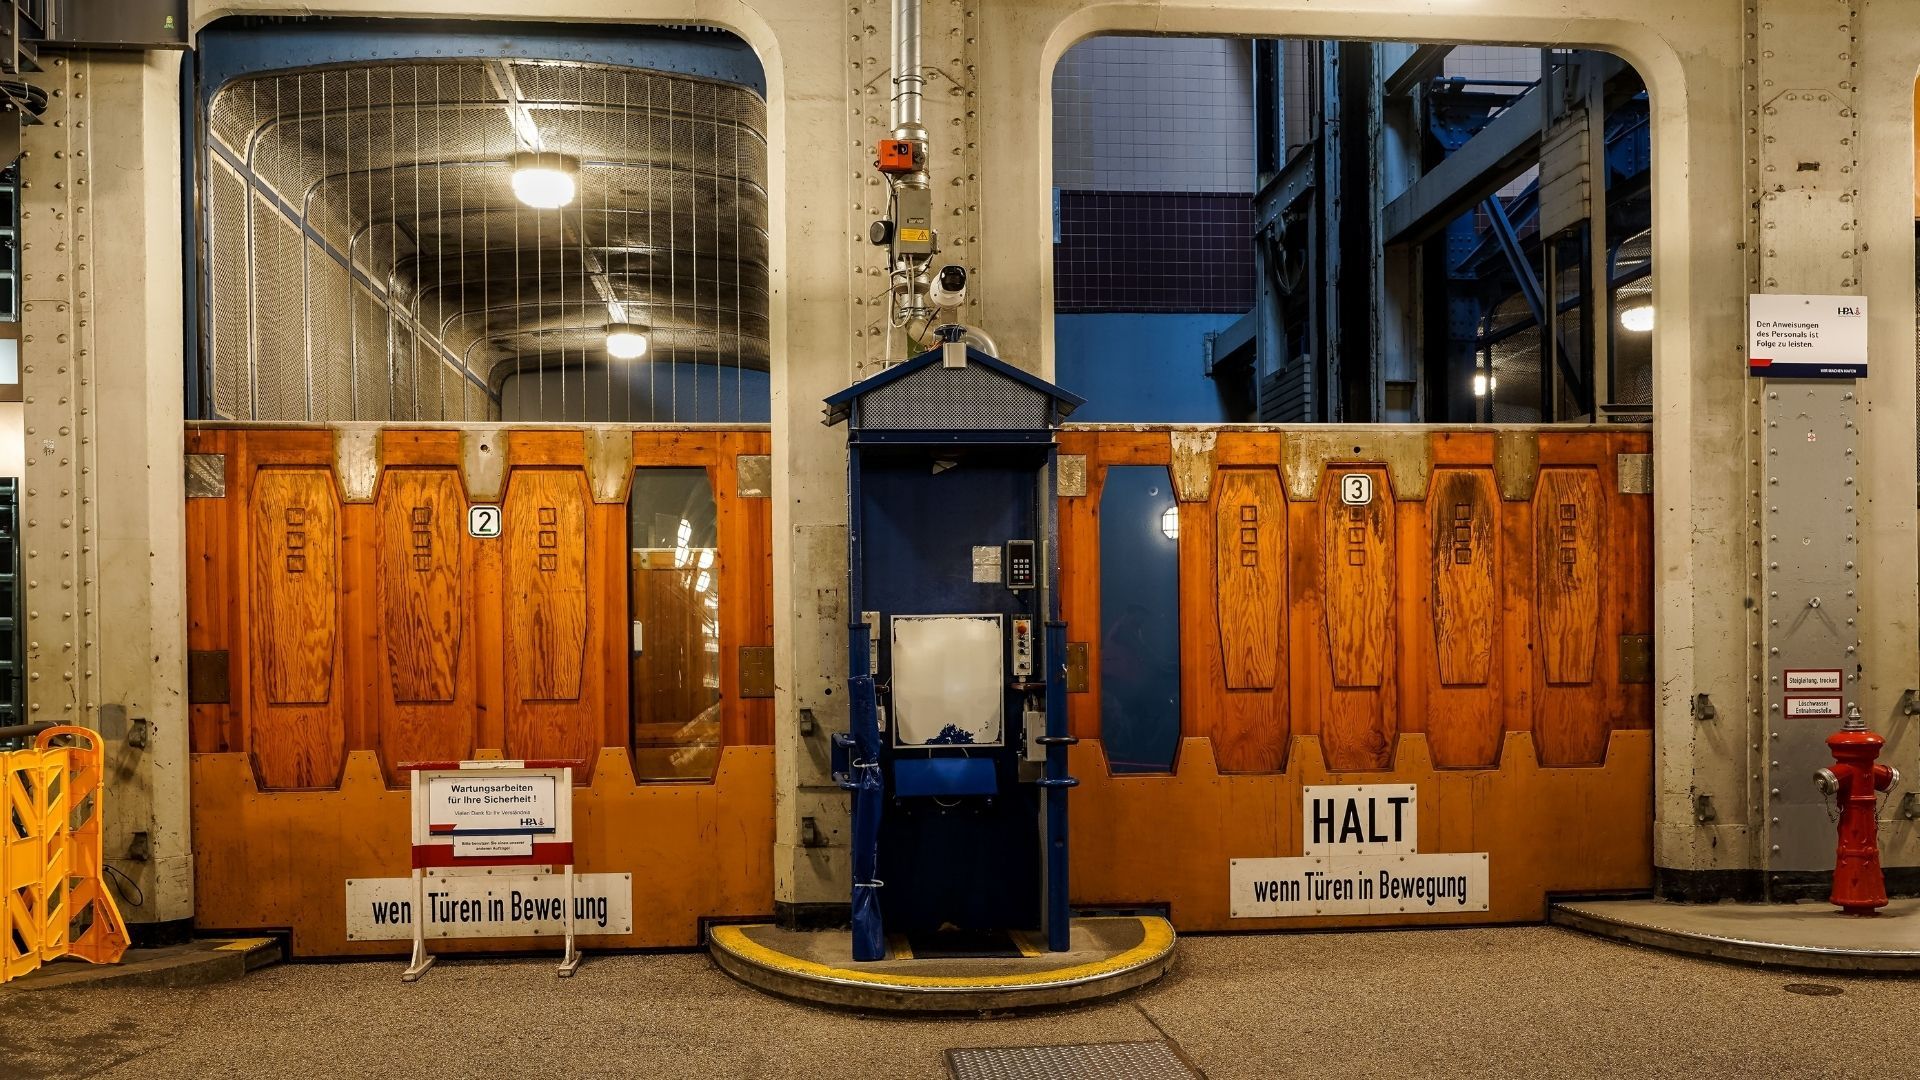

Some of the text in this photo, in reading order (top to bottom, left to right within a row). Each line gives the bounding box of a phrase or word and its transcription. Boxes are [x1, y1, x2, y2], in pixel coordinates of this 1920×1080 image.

[1838, 307, 1854, 315] HPA
[1756, 320, 1819, 330] Den Anweisungen
[1771, 331, 1807, 339] Personals
[1756, 340, 1776, 349] Folge
[1788, 340, 1813, 348] leisten.
[1352, 479, 1363, 499] 3
[479, 511, 491, 532] 2
[451, 784, 533, 794] Wartungsarbeiten
[448, 796, 461, 804] für
[463, 796, 481, 804] Ihre
[484, 795, 531, 804] Sicherheit
[520, 818, 538, 826] HPA
[1313, 797, 1409, 843] HALT
[1254, 870, 1467, 906] wenn Türen in Bewegung
[371, 890, 607, 928] wen Türen in Beweung
